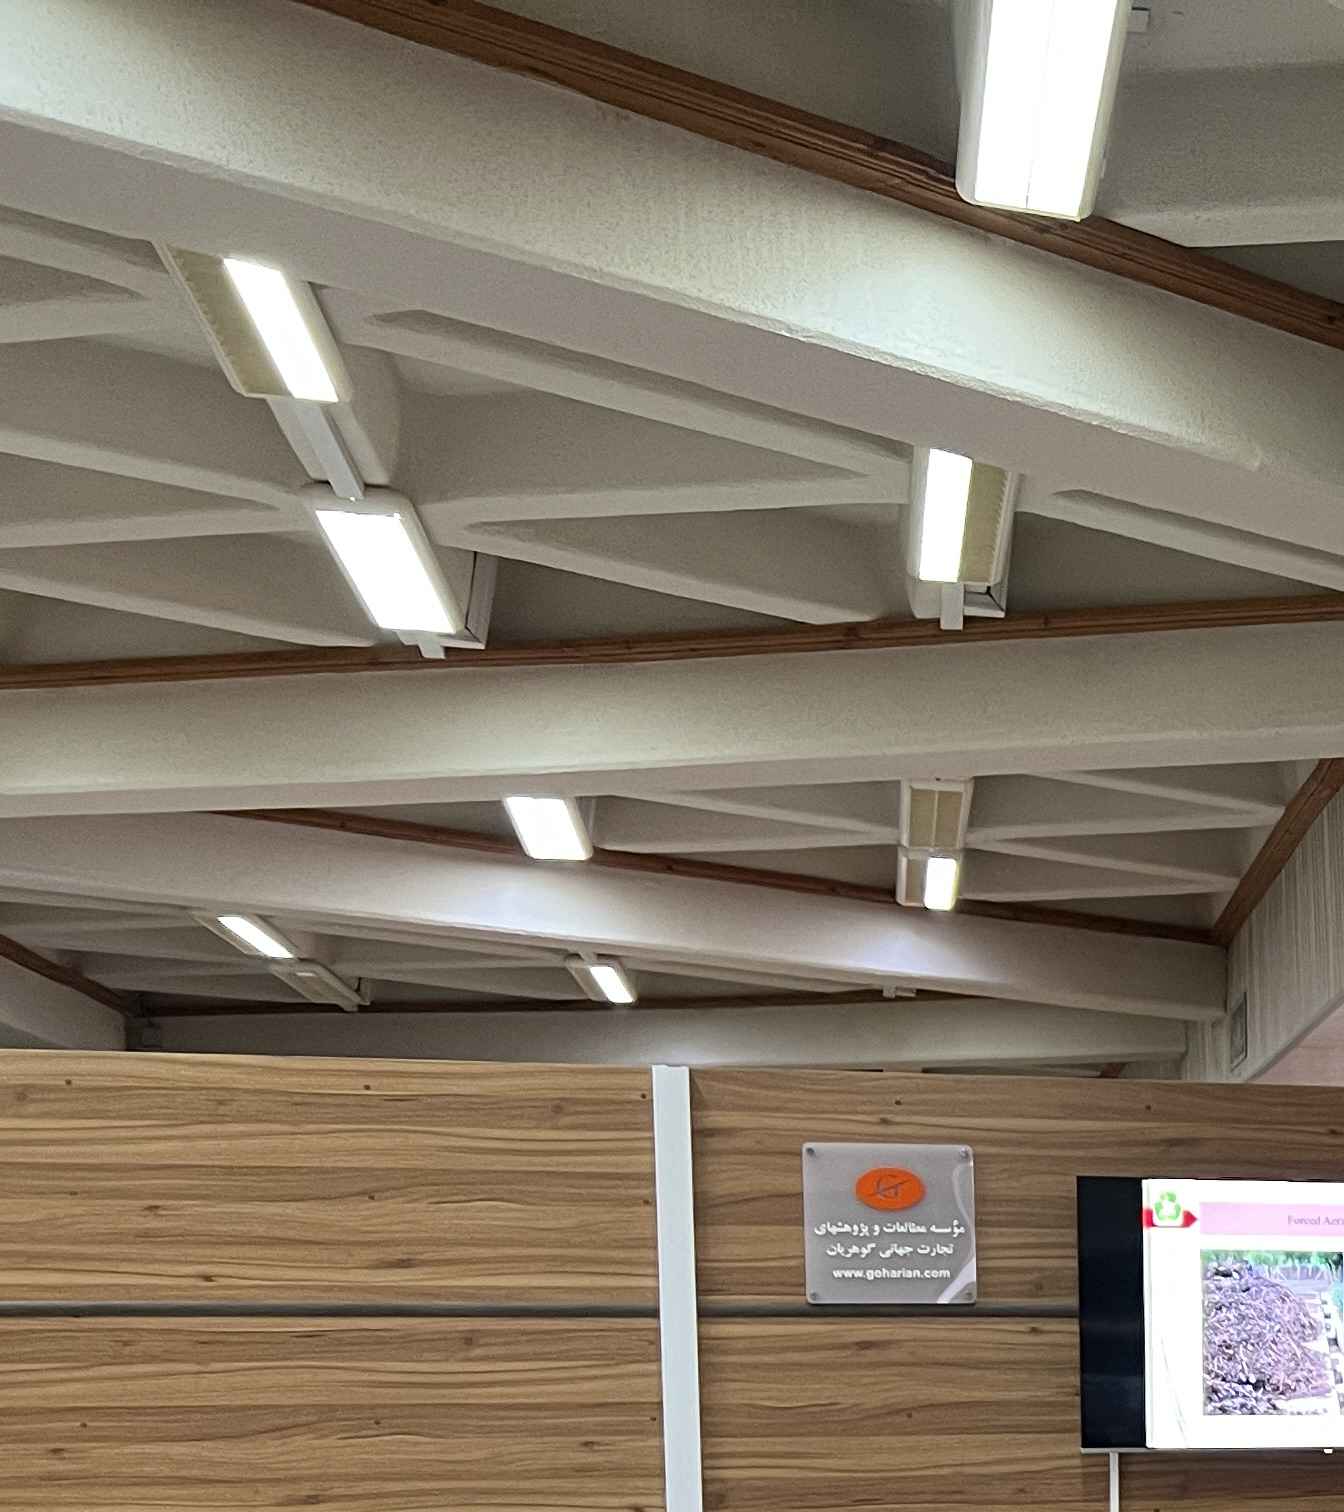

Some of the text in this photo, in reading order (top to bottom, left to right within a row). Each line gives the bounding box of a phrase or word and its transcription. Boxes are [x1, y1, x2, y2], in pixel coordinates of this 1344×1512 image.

[1287, 1215, 1321, 1225] Forced
[872, 1225, 881, 1236] و
[882, 1221, 928, 1234] مطالعات
[879, 1243, 914, 1258] جهانی
[916, 1243, 954, 1257] تجارت
[832, 1267, 951, 1281] www.goharian.com
